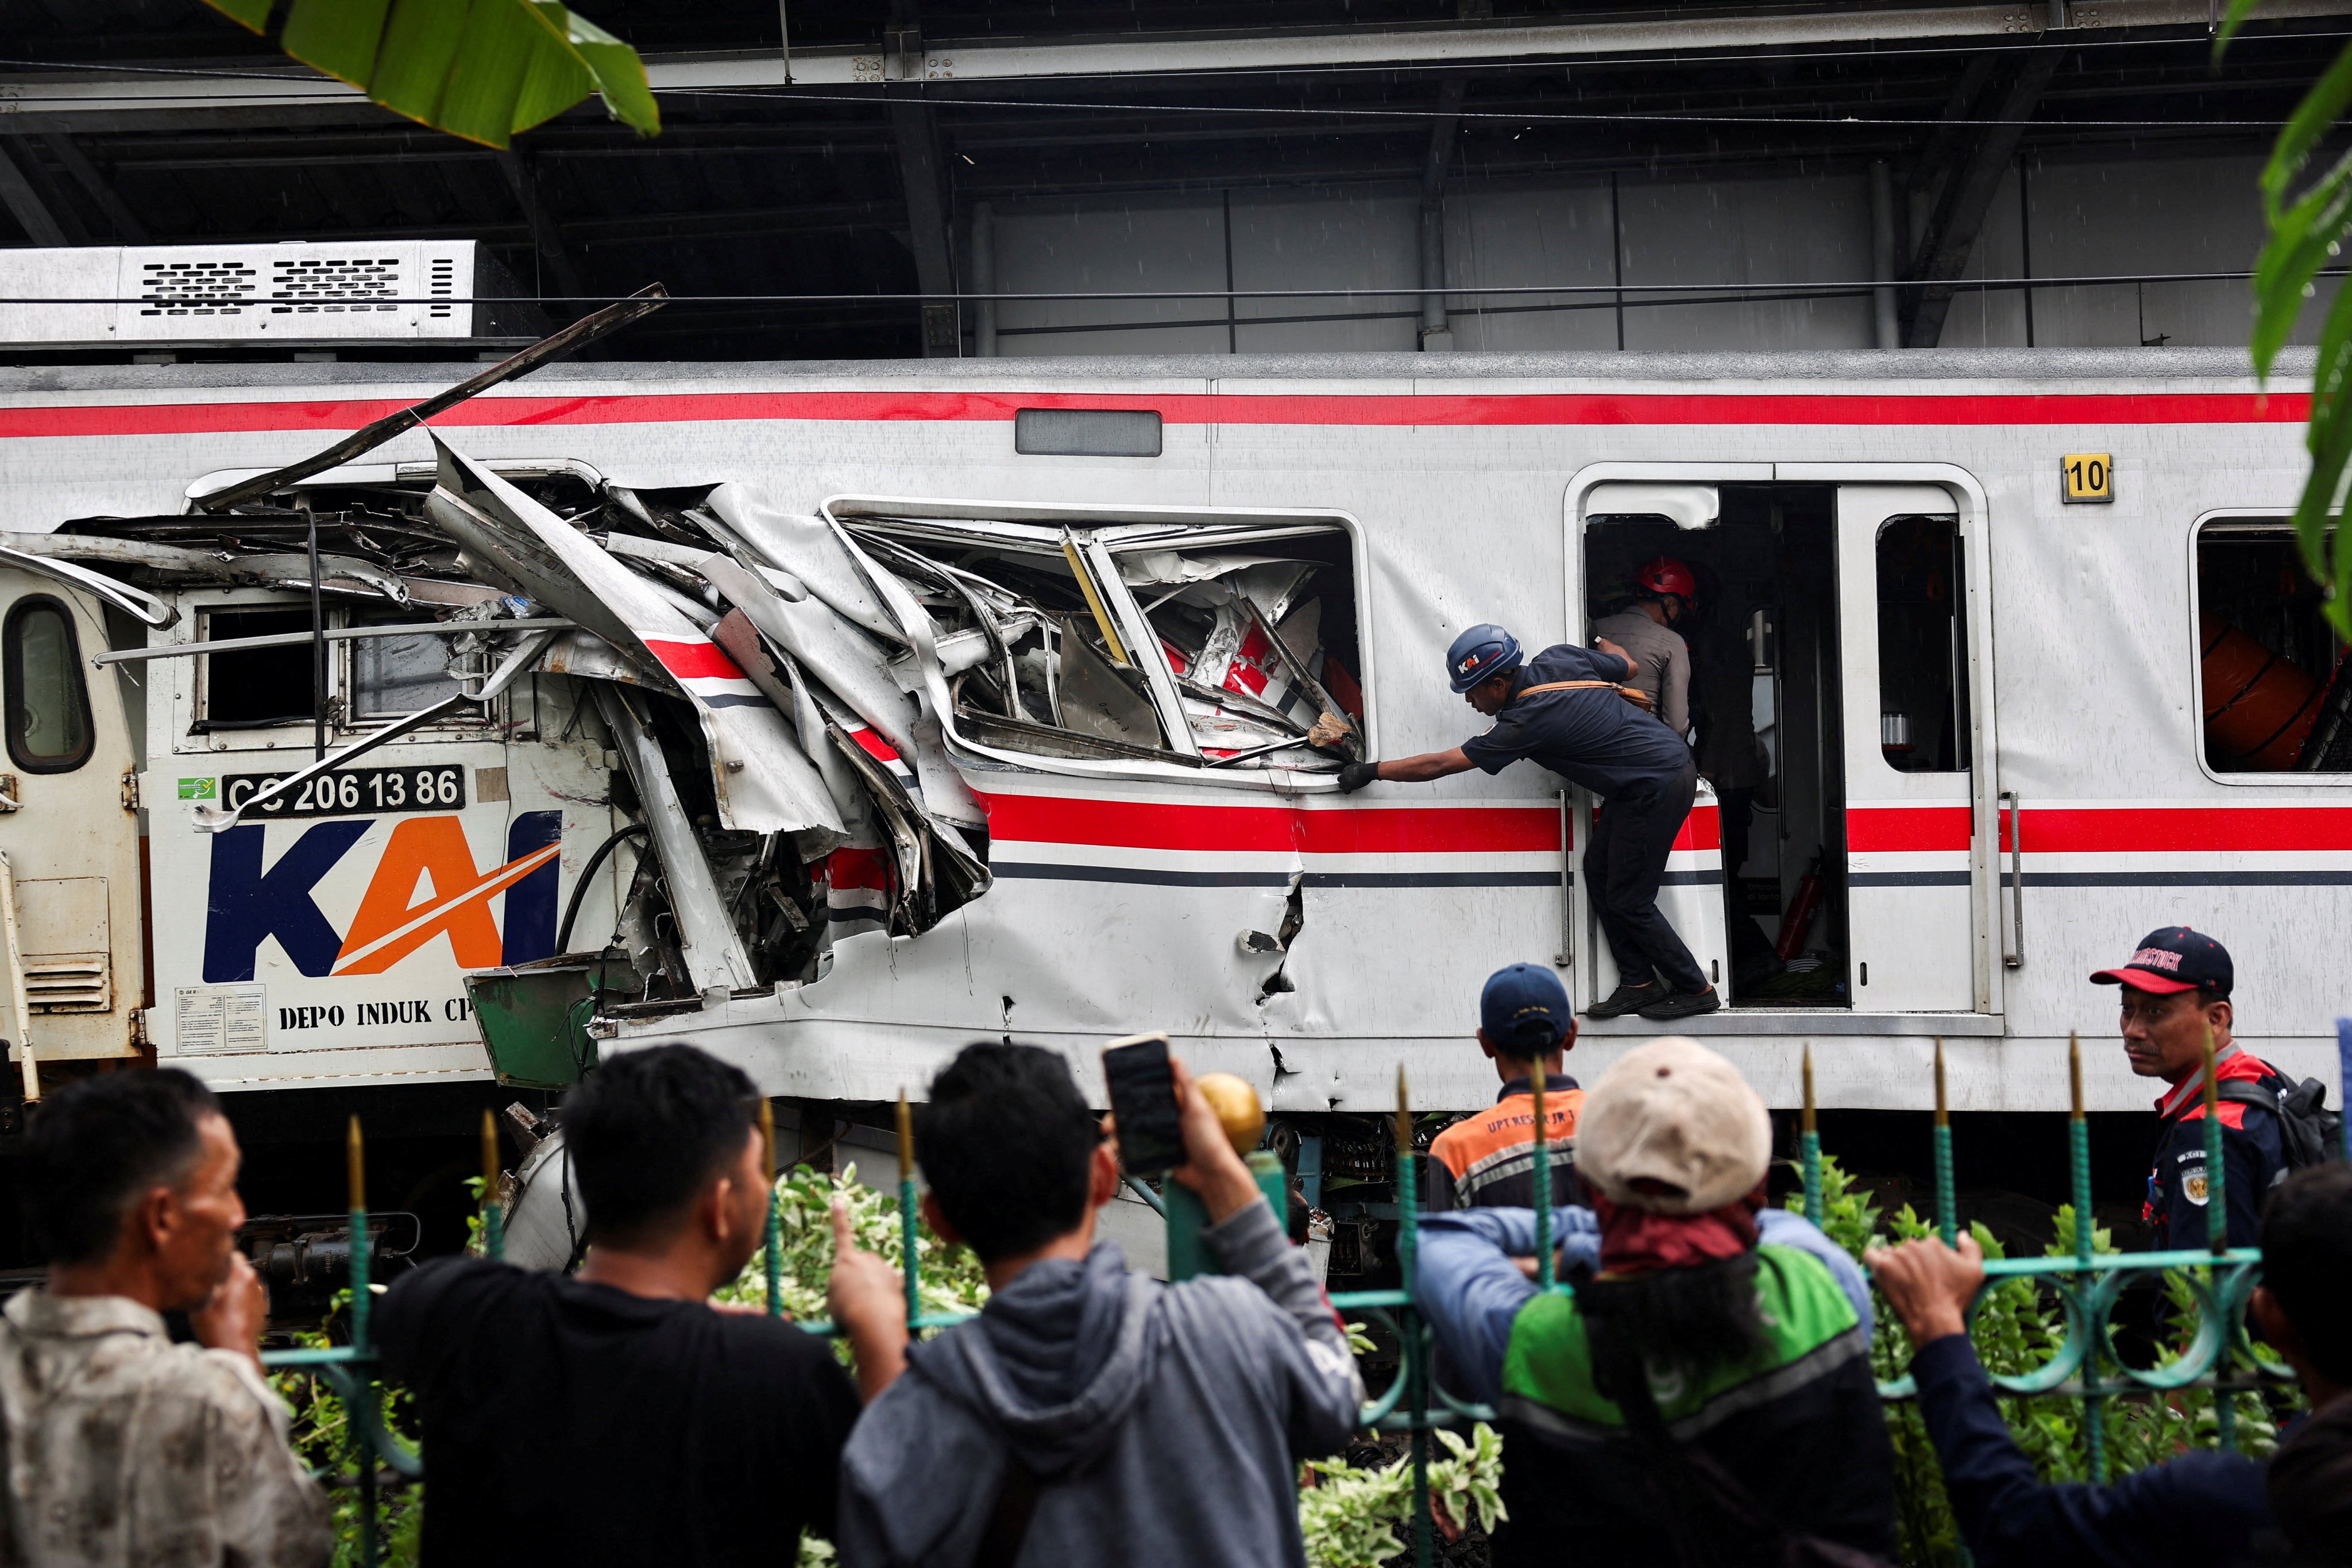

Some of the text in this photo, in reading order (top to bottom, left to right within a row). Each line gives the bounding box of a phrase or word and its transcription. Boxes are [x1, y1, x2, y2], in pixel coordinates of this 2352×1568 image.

[2071, 460, 2104, 491] 10
[1458, 654, 1480, 674] KAI
[1475, 650, 1501, 670] Commuter
[293, 774, 360, 810] 206
[369, 773, 406, 807] 13
[416, 770, 458, 804] 86
[202, 810, 563, 984] KAI
[279, 1005, 345, 1030] DEPO
[357, 1000, 432, 1025] INDUK
[1488, 1117, 1510, 1133] UPT
[1512, 1113, 1549, 1127] RESR
[1551, 1111, 1565, 1125] JR
